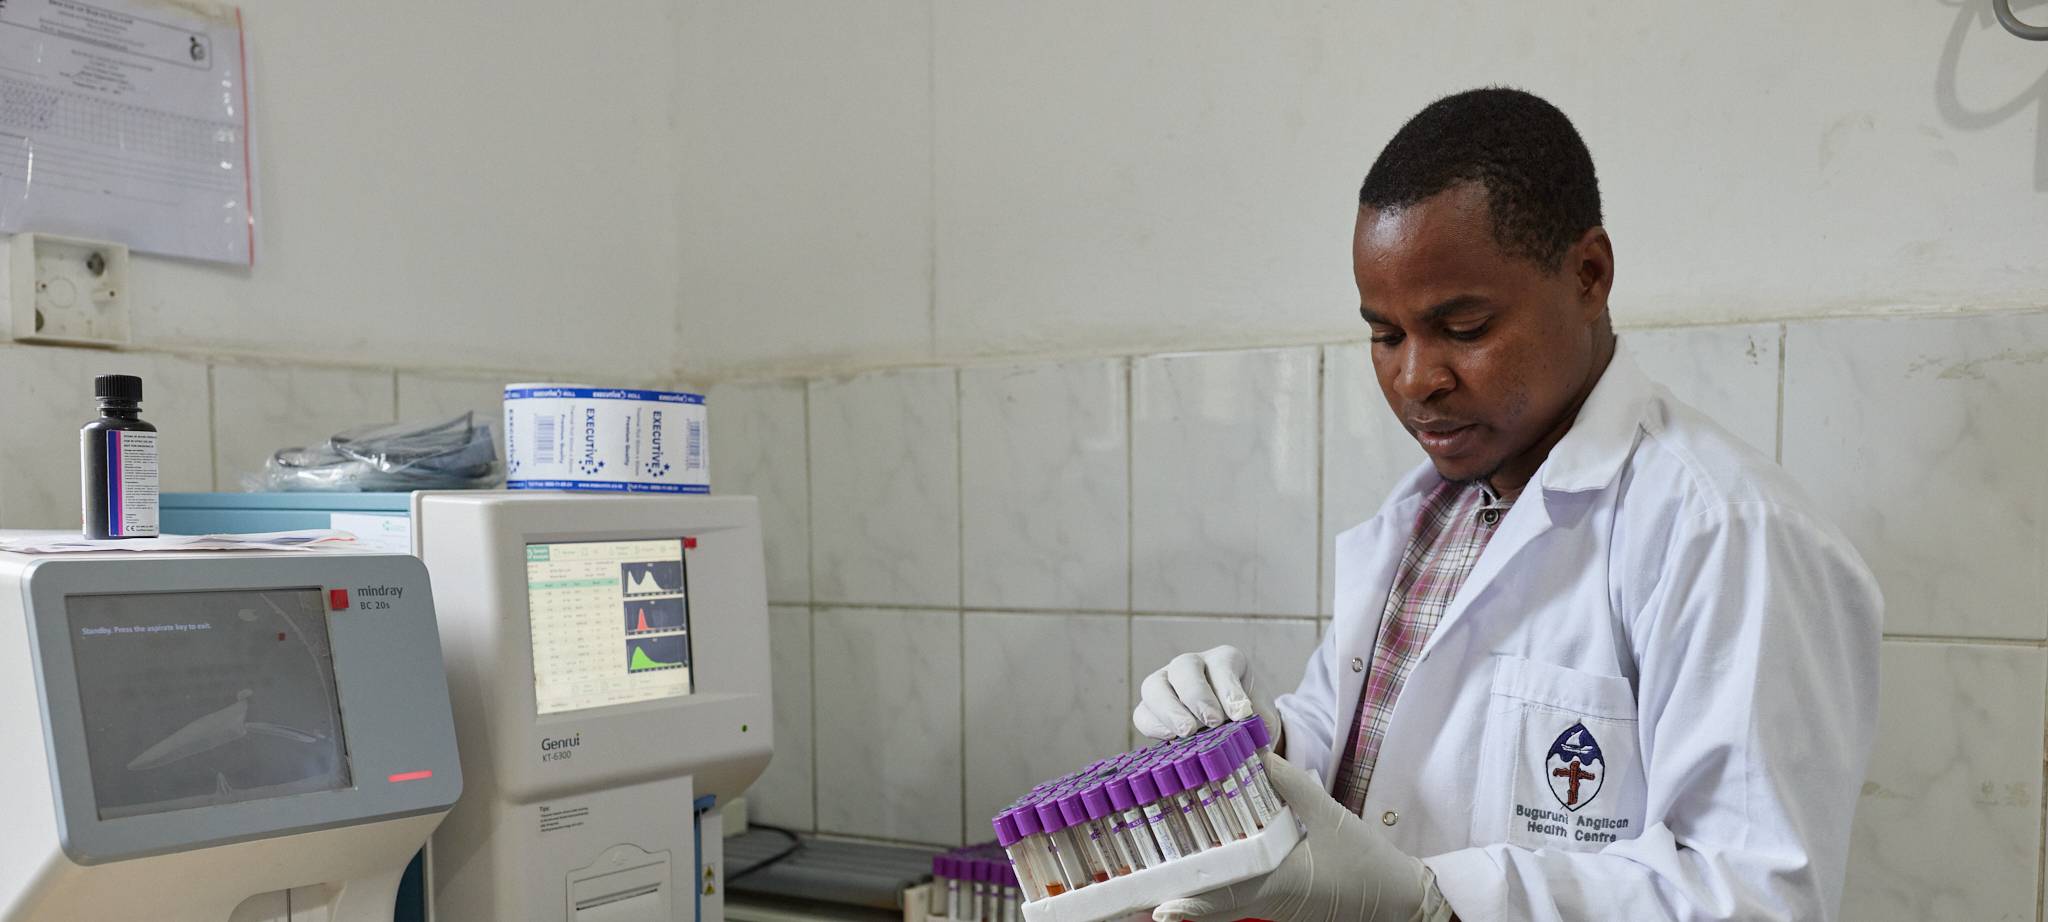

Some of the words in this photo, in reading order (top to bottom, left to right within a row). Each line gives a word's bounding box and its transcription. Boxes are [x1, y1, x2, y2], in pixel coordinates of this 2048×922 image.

[358, 585, 403, 598] mindray
[175, 623, 187, 631] key
[541, 732, 580, 750] Genrui
[542, 750, 572, 762] KT-6300
[1516, 804, 1568, 824] Buguruni
[1576, 815, 1629, 830] Anglican
[1527, 821, 1567, 837] Health
[1575, 829, 1616, 842] Centre
